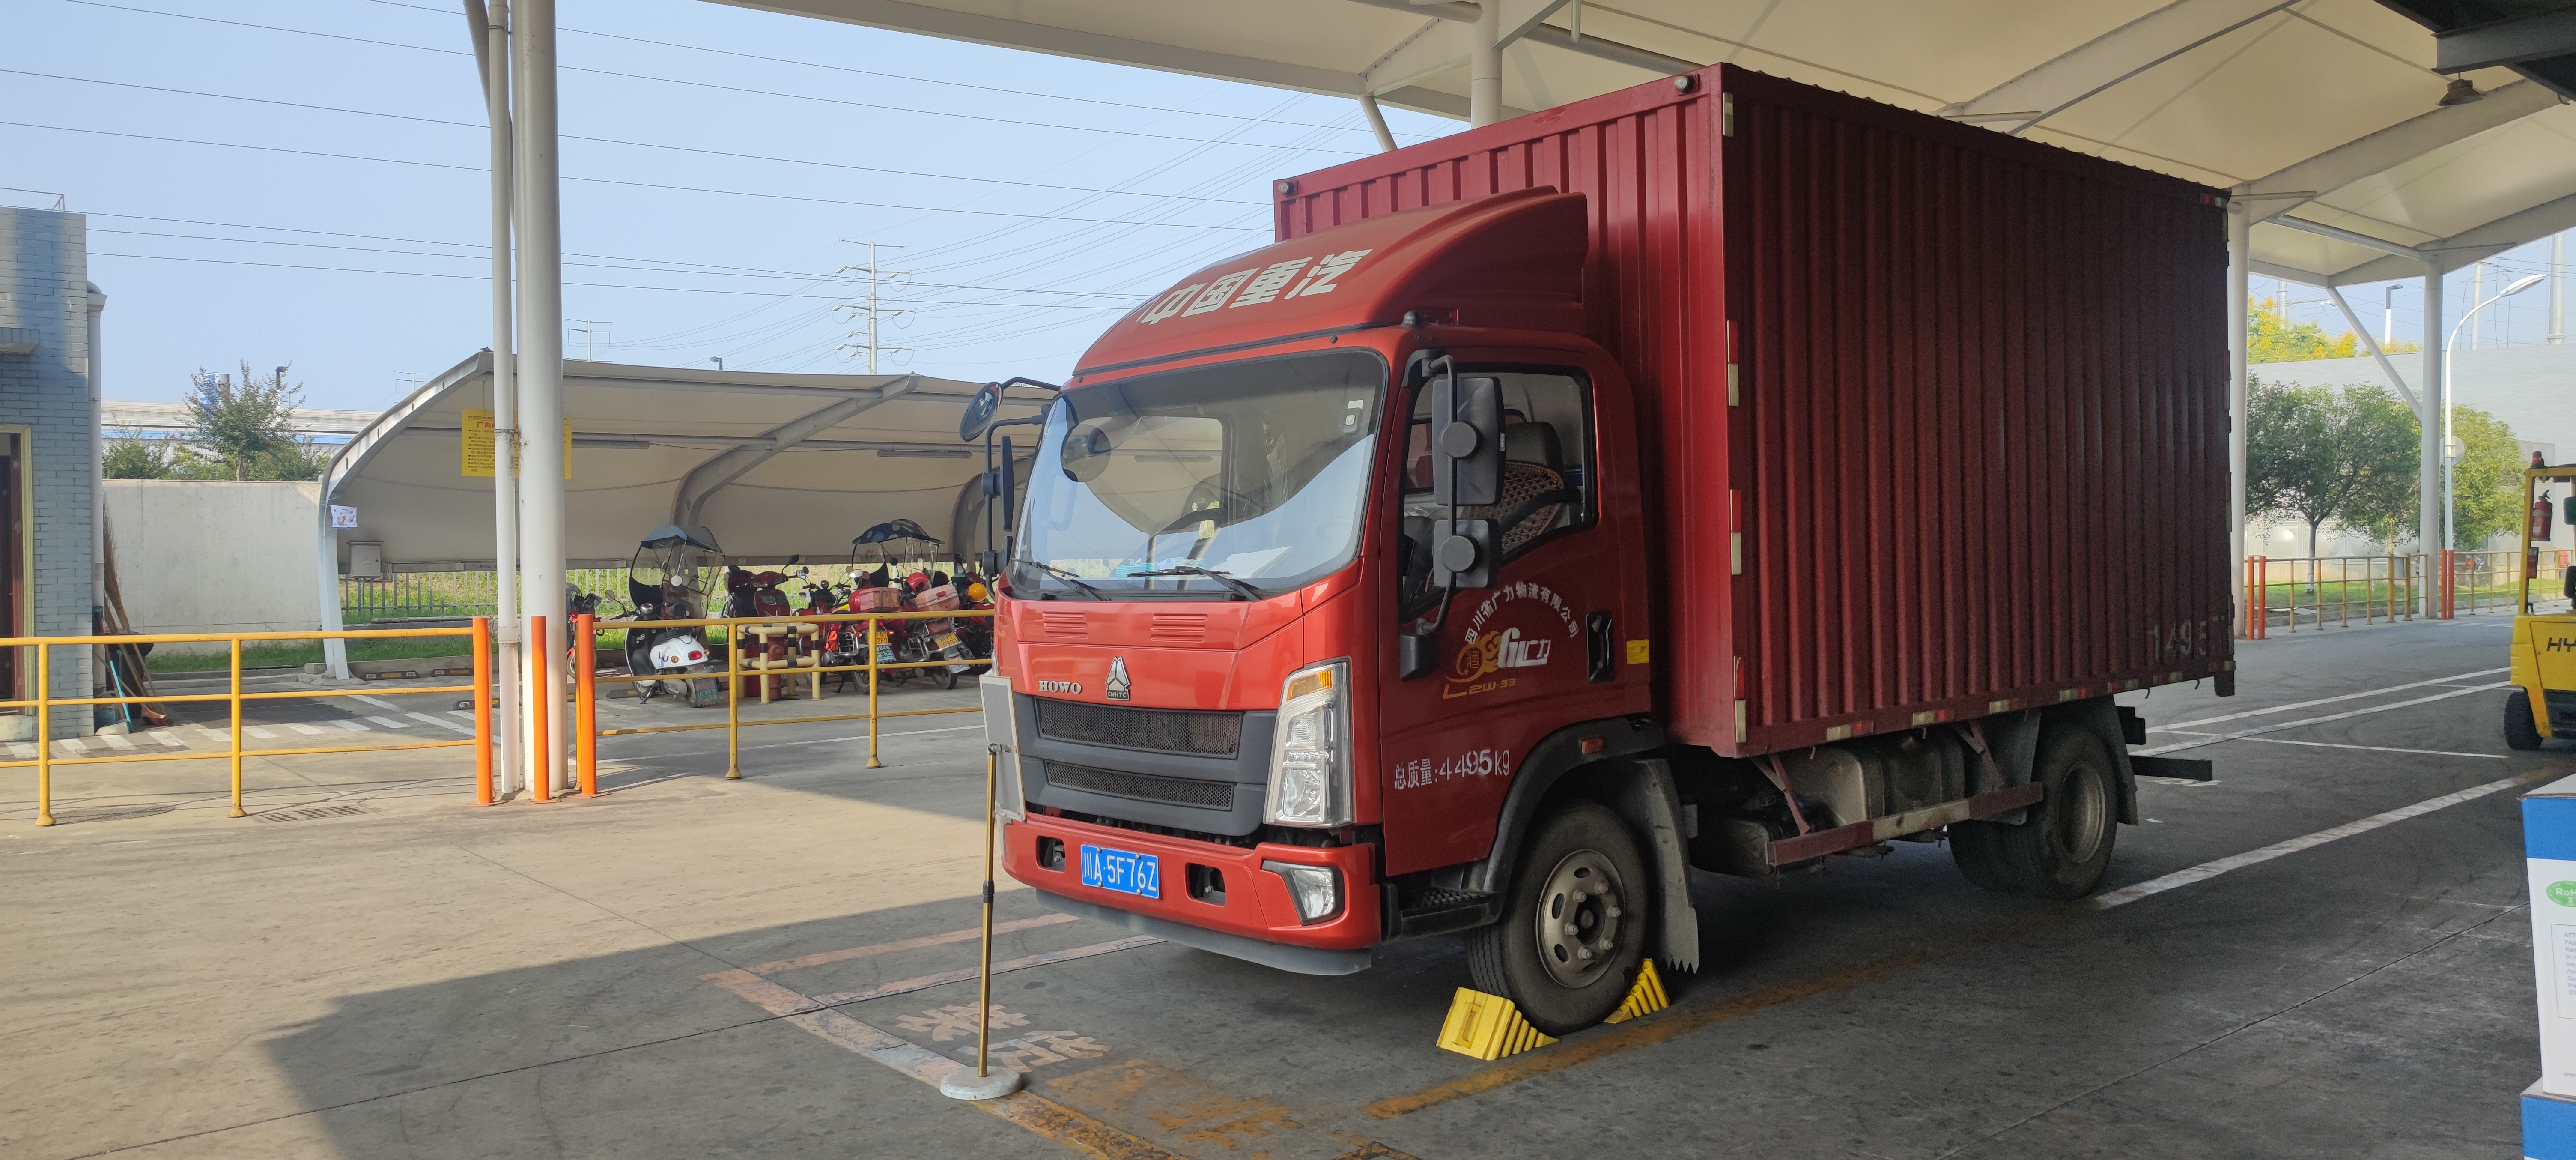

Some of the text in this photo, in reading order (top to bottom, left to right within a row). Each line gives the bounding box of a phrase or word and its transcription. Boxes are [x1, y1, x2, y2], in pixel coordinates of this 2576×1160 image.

[1136, 248, 1373, 325] 中国重汽
[1464, 581, 1579, 645] 四川省广力物流有限公司
[1038, 680, 1082, 694] HOWO
